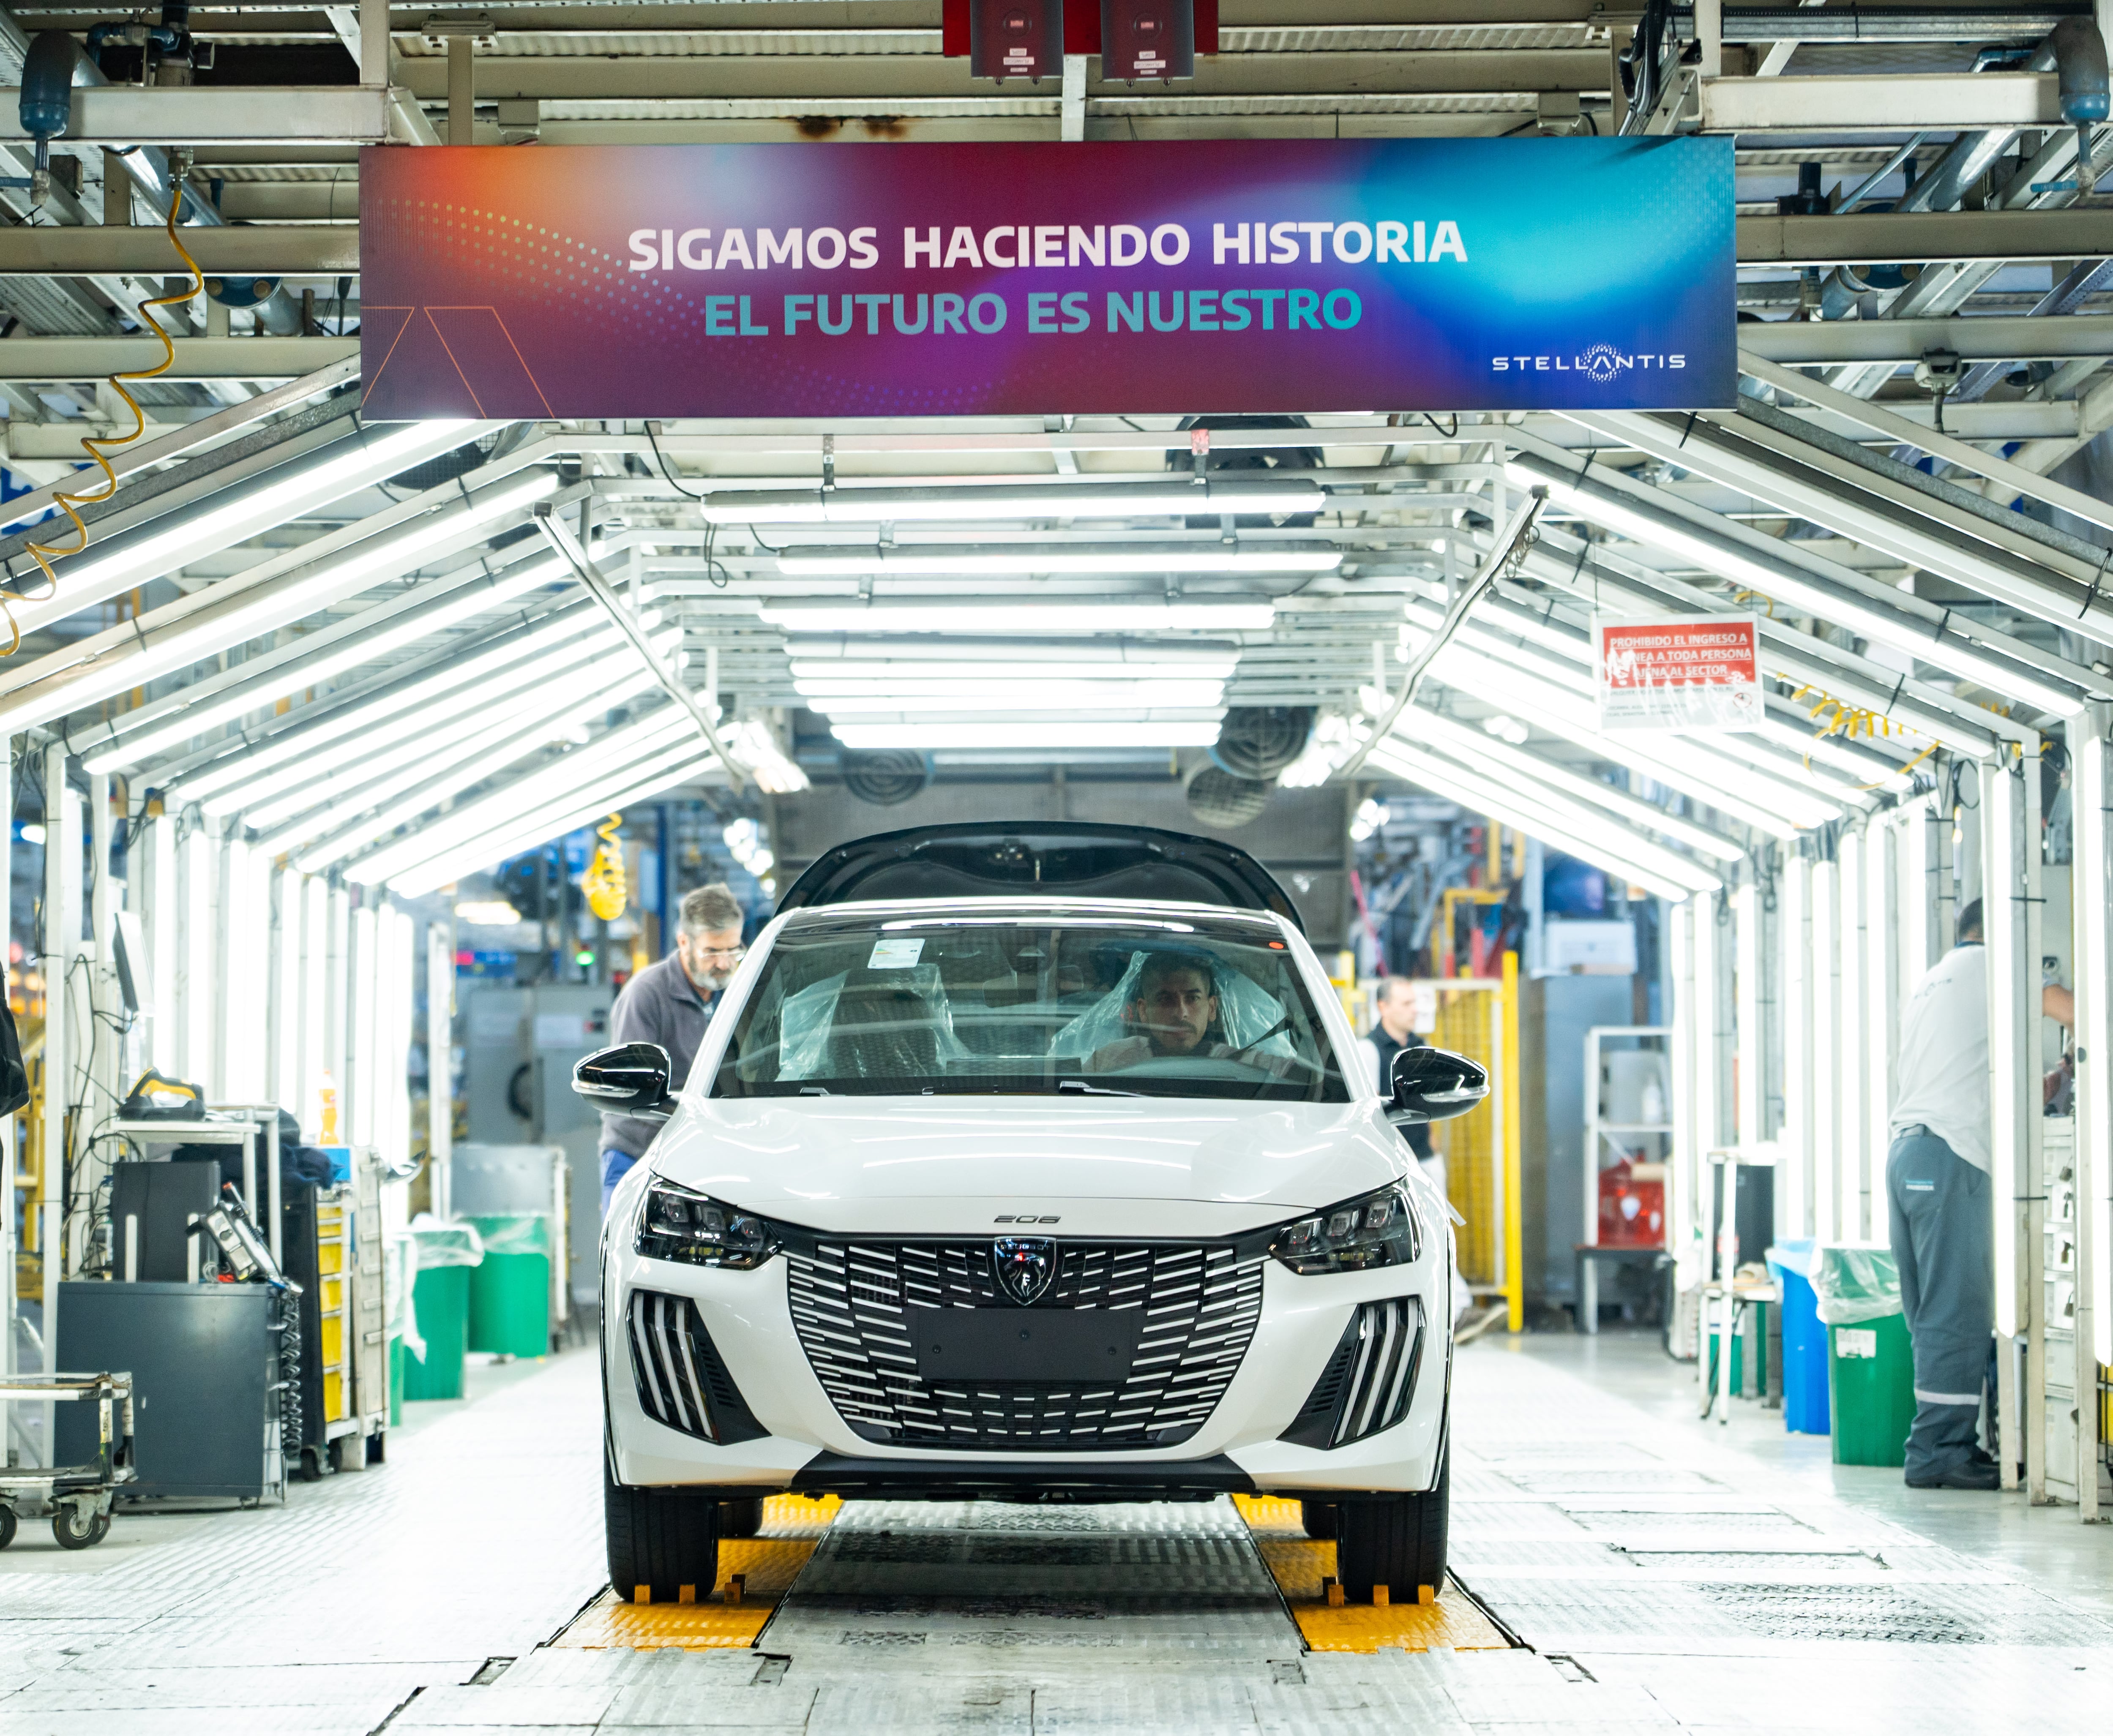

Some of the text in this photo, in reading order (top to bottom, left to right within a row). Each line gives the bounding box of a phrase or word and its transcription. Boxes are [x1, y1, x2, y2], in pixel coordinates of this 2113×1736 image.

[628, 221, 1468, 271] SIGAMOS HACIENDO HISTORIA
[705, 288, 1362, 336] EL FUTURO ES NUESTRO
[1492, 354, 1686, 371] STELLANTIS
[1610, 633, 1747, 647] PROHIBIDO EL INGRESO A
[1657, 651, 1665, 662] A
[1667, 649, 1699, 661] TODA
[1701, 648, 1752, 660] PERSONA
[1670, 666, 1684, 677] AL
[1685, 665, 1728, 676] SECTOR
[994, 1215, 1061, 1223] 208
